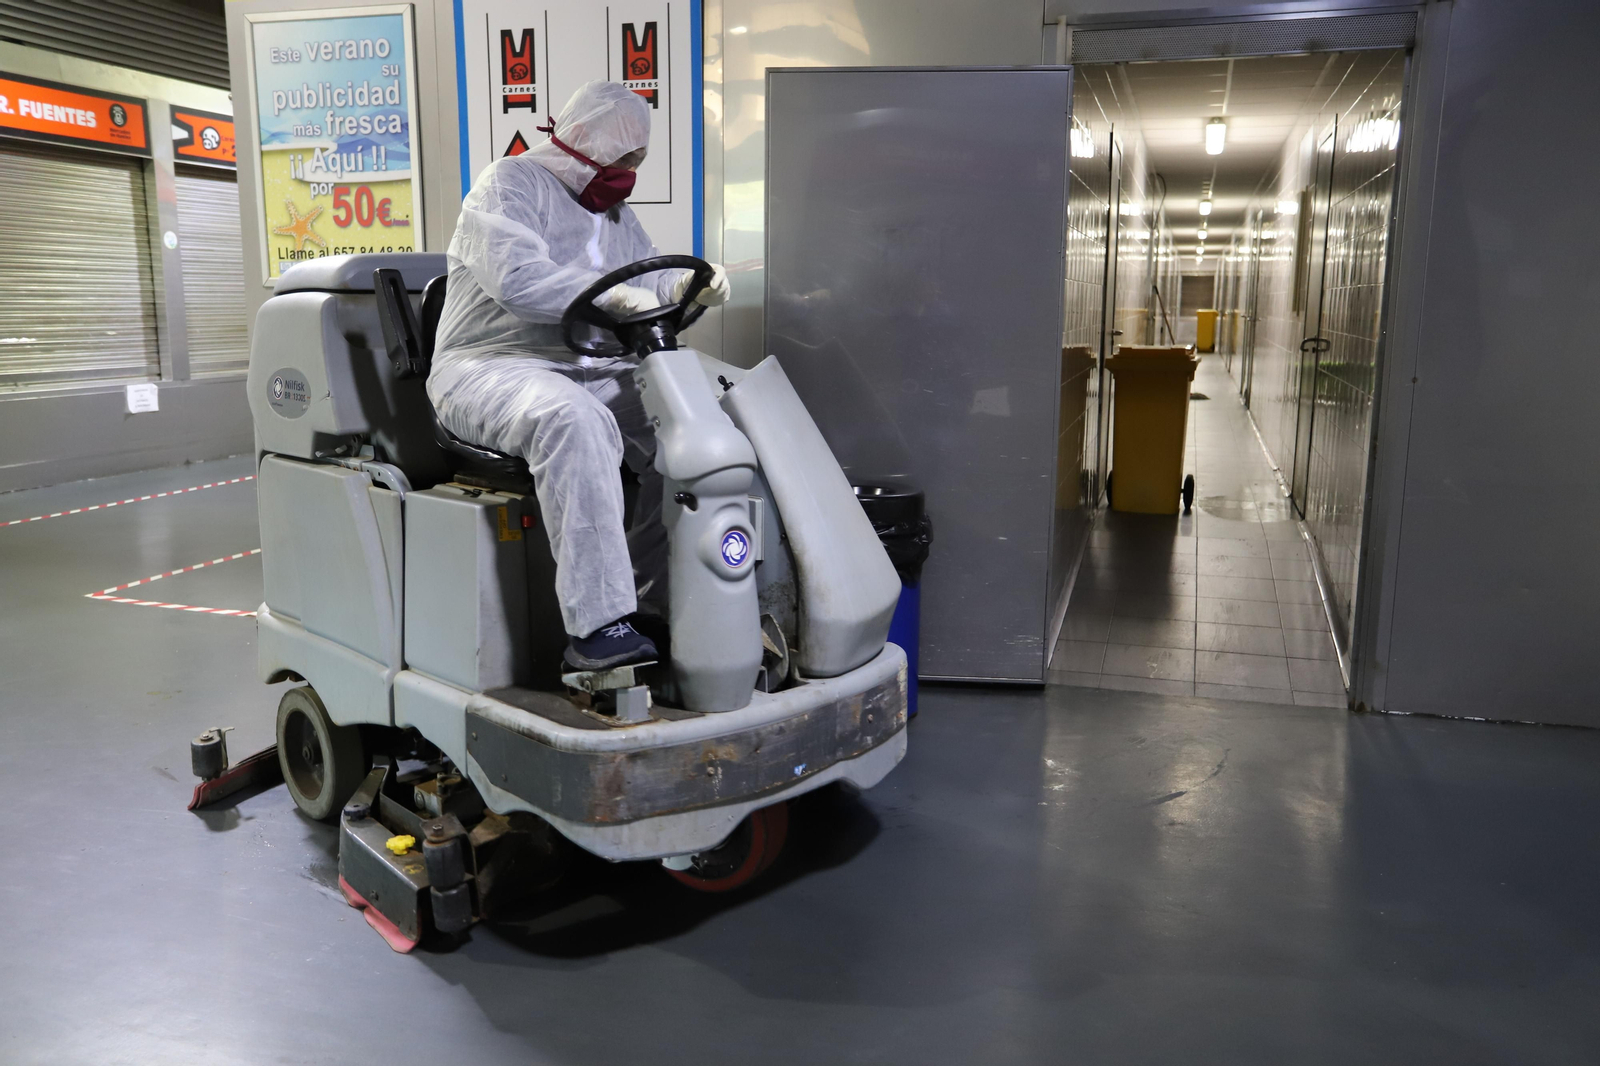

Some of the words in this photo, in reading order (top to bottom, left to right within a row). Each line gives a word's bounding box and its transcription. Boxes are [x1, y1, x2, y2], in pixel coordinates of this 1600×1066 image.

[270, 47, 301, 63] Este
[304, 37, 391, 61] verano
[381, 63, 399, 76] su
[502, 86, 536, 94] Carnes
[623, 80, 659, 89] Carnes
[272, 79, 401, 115] publicidad
[18, 98, 97, 128] FUENTES
[293, 121, 322, 136] más
[325, 110, 402, 136] fresca
[310, 145, 364, 178] Aquí
[310, 182, 334, 199] por
[278, 247, 315, 260] Llame
[319, 247, 330, 258] al
[333, 246, 355, 256] 657
[284, 380, 305, 392] Nilfisk
